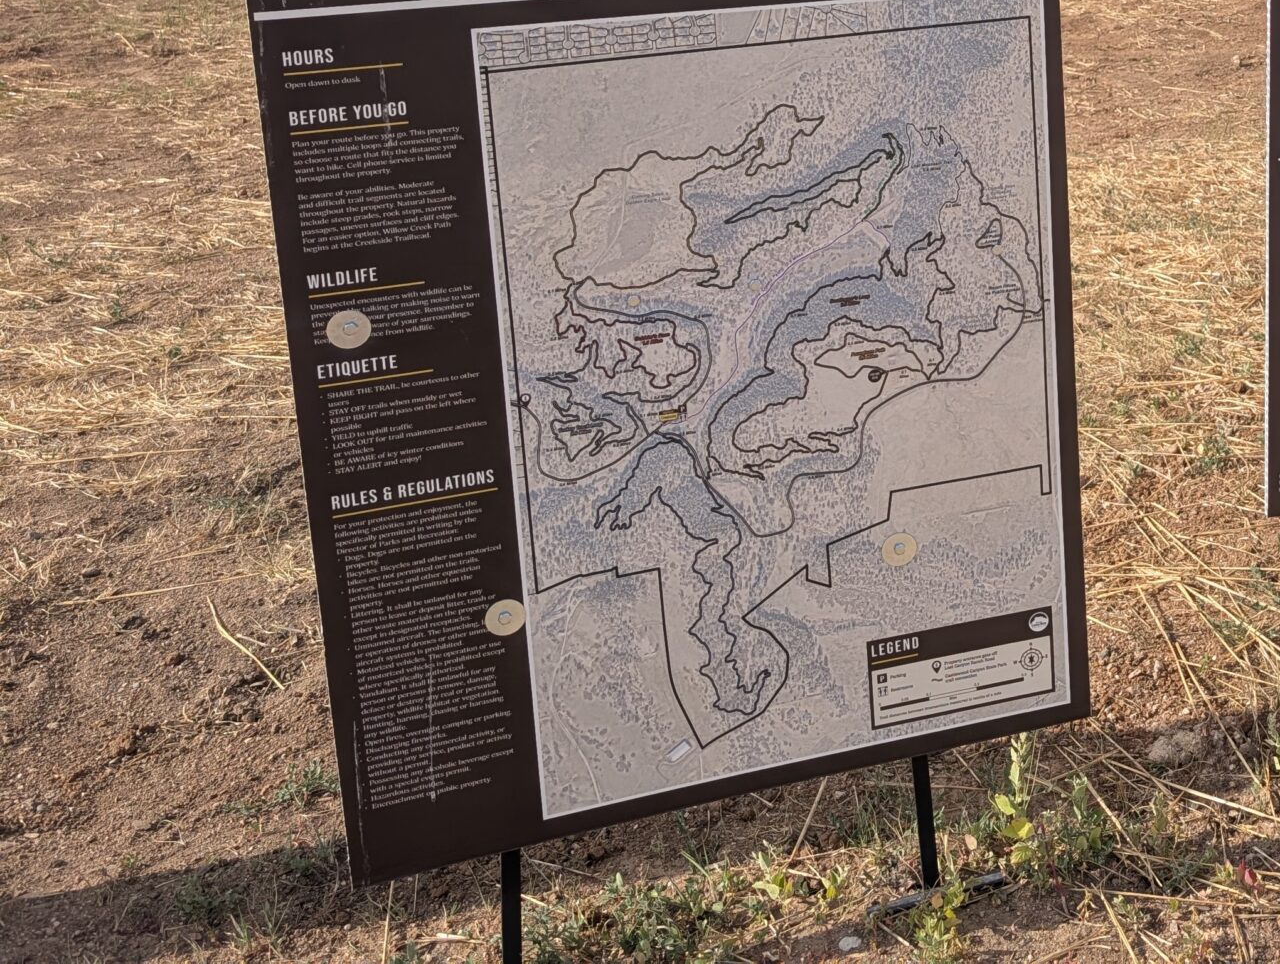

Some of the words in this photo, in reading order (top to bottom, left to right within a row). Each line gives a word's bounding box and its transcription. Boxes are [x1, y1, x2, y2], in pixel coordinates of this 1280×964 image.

[281, 48, 334, 67] HOURS
[284, 81, 306, 90] Open
[288, 106, 348, 126] BEFORE
[352, 103, 382, 120] YOU
[387, 100, 407, 117] GO
[310, 139, 329, 147] your
[354, 133, 379, 141] before
[427, 126, 459, 136] property
[399, 136, 441, 147] connecting
[306, 266, 378, 289] WILDLIFE
[316, 354, 398, 380] ETIQUETTE
[330, 488, 378, 510] RULES
[382, 486, 392, 501] &
[397, 468, 494, 498] REGULATIONS
[871, 637, 919, 657] LEGEND
